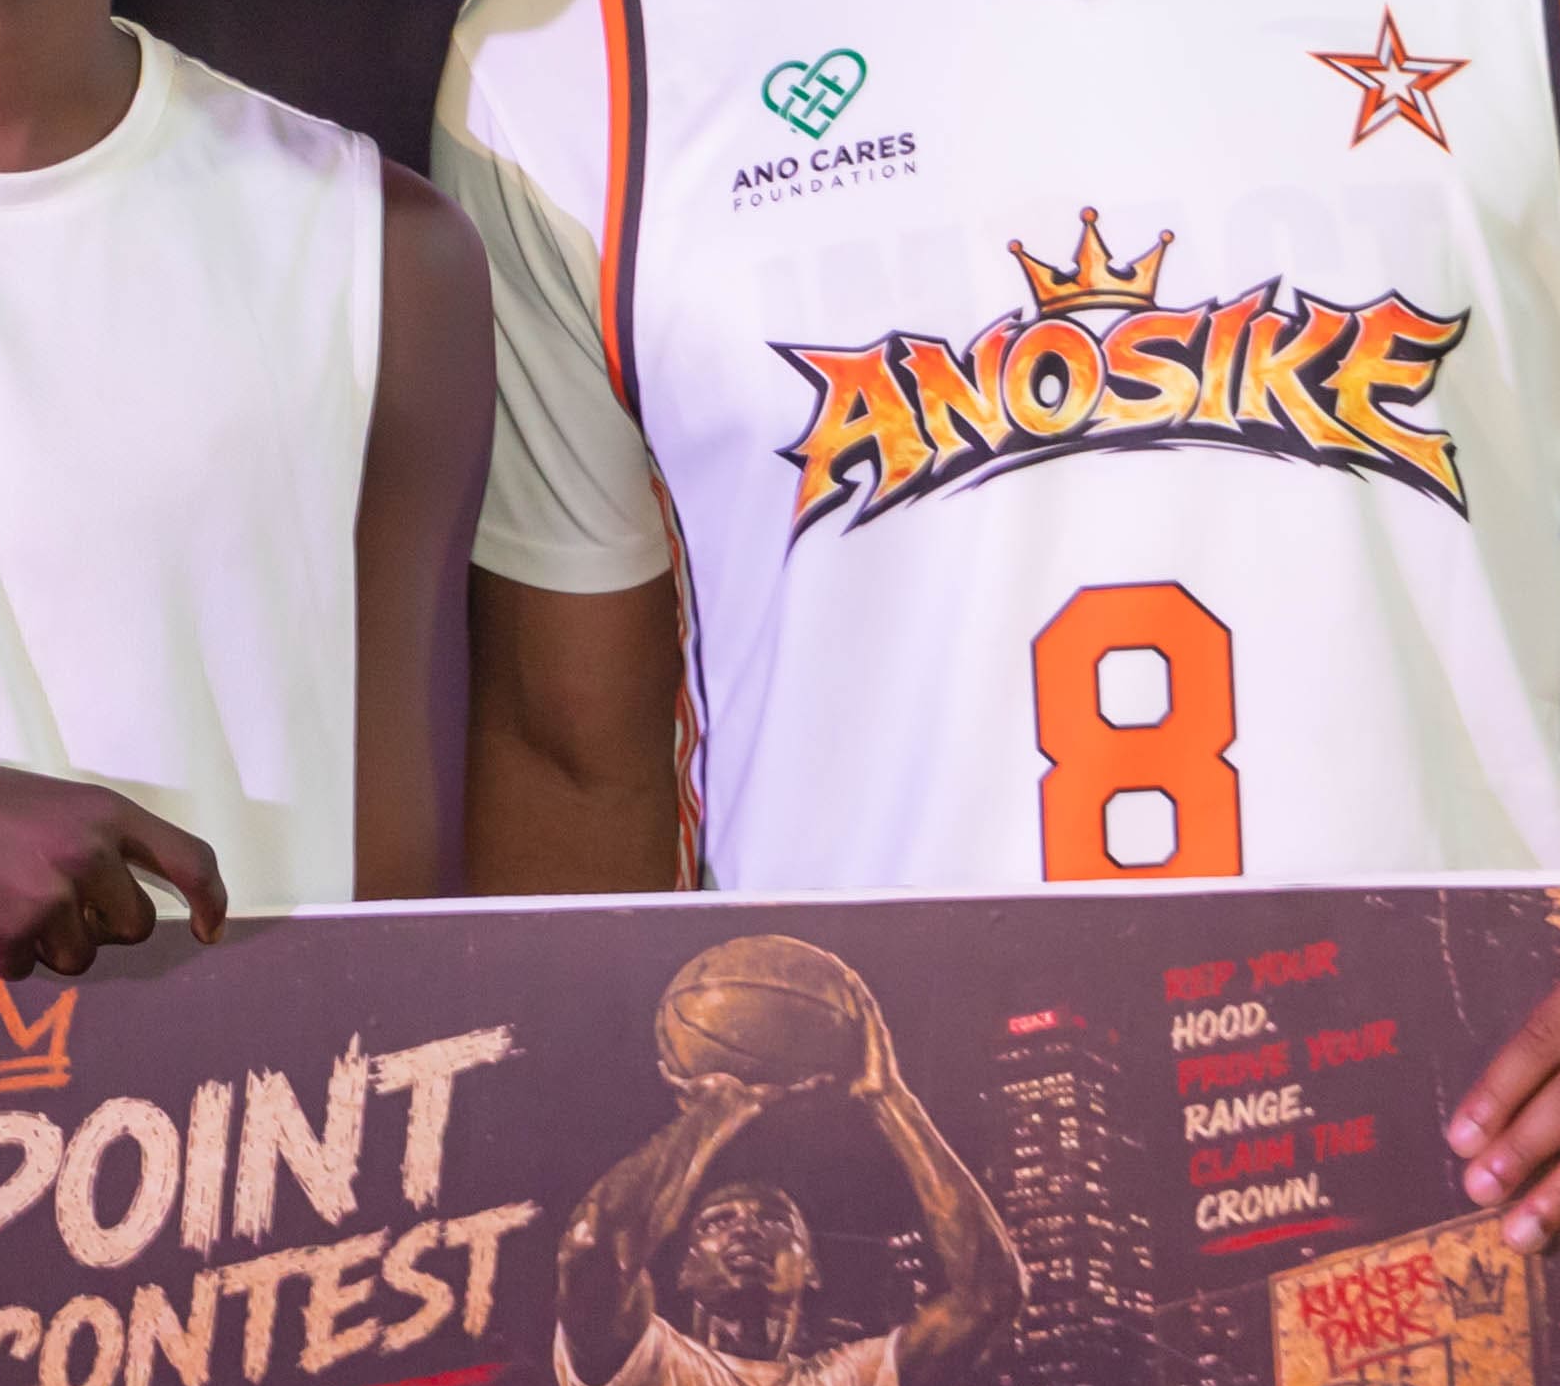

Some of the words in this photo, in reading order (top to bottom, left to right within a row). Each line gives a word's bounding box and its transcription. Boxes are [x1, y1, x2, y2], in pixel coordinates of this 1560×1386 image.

[732, 157, 799, 192] ANO
[810, 132, 916, 171] CARES
[733, 162, 916, 211] FOUNDATION
[770, 277, 1468, 553] ANOSIKE
[1031, 580, 1242, 881] 8
[1163, 960, 1236, 1003] REP
[1248, 940, 1340, 991] YOUR
[1171, 1002, 1277, 1051] HOOD.
[1178, 1041, 1290, 1096] PROVE
[1305, 1020, 1398, 1072] YOUR
[1184, 1084, 1315, 1142] RANGE.
[1190, 1133, 1296, 1186] CLAIM
[1311, 1115, 1376, 1163] THE
[1196, 1173, 1332, 1231] CROWN.
